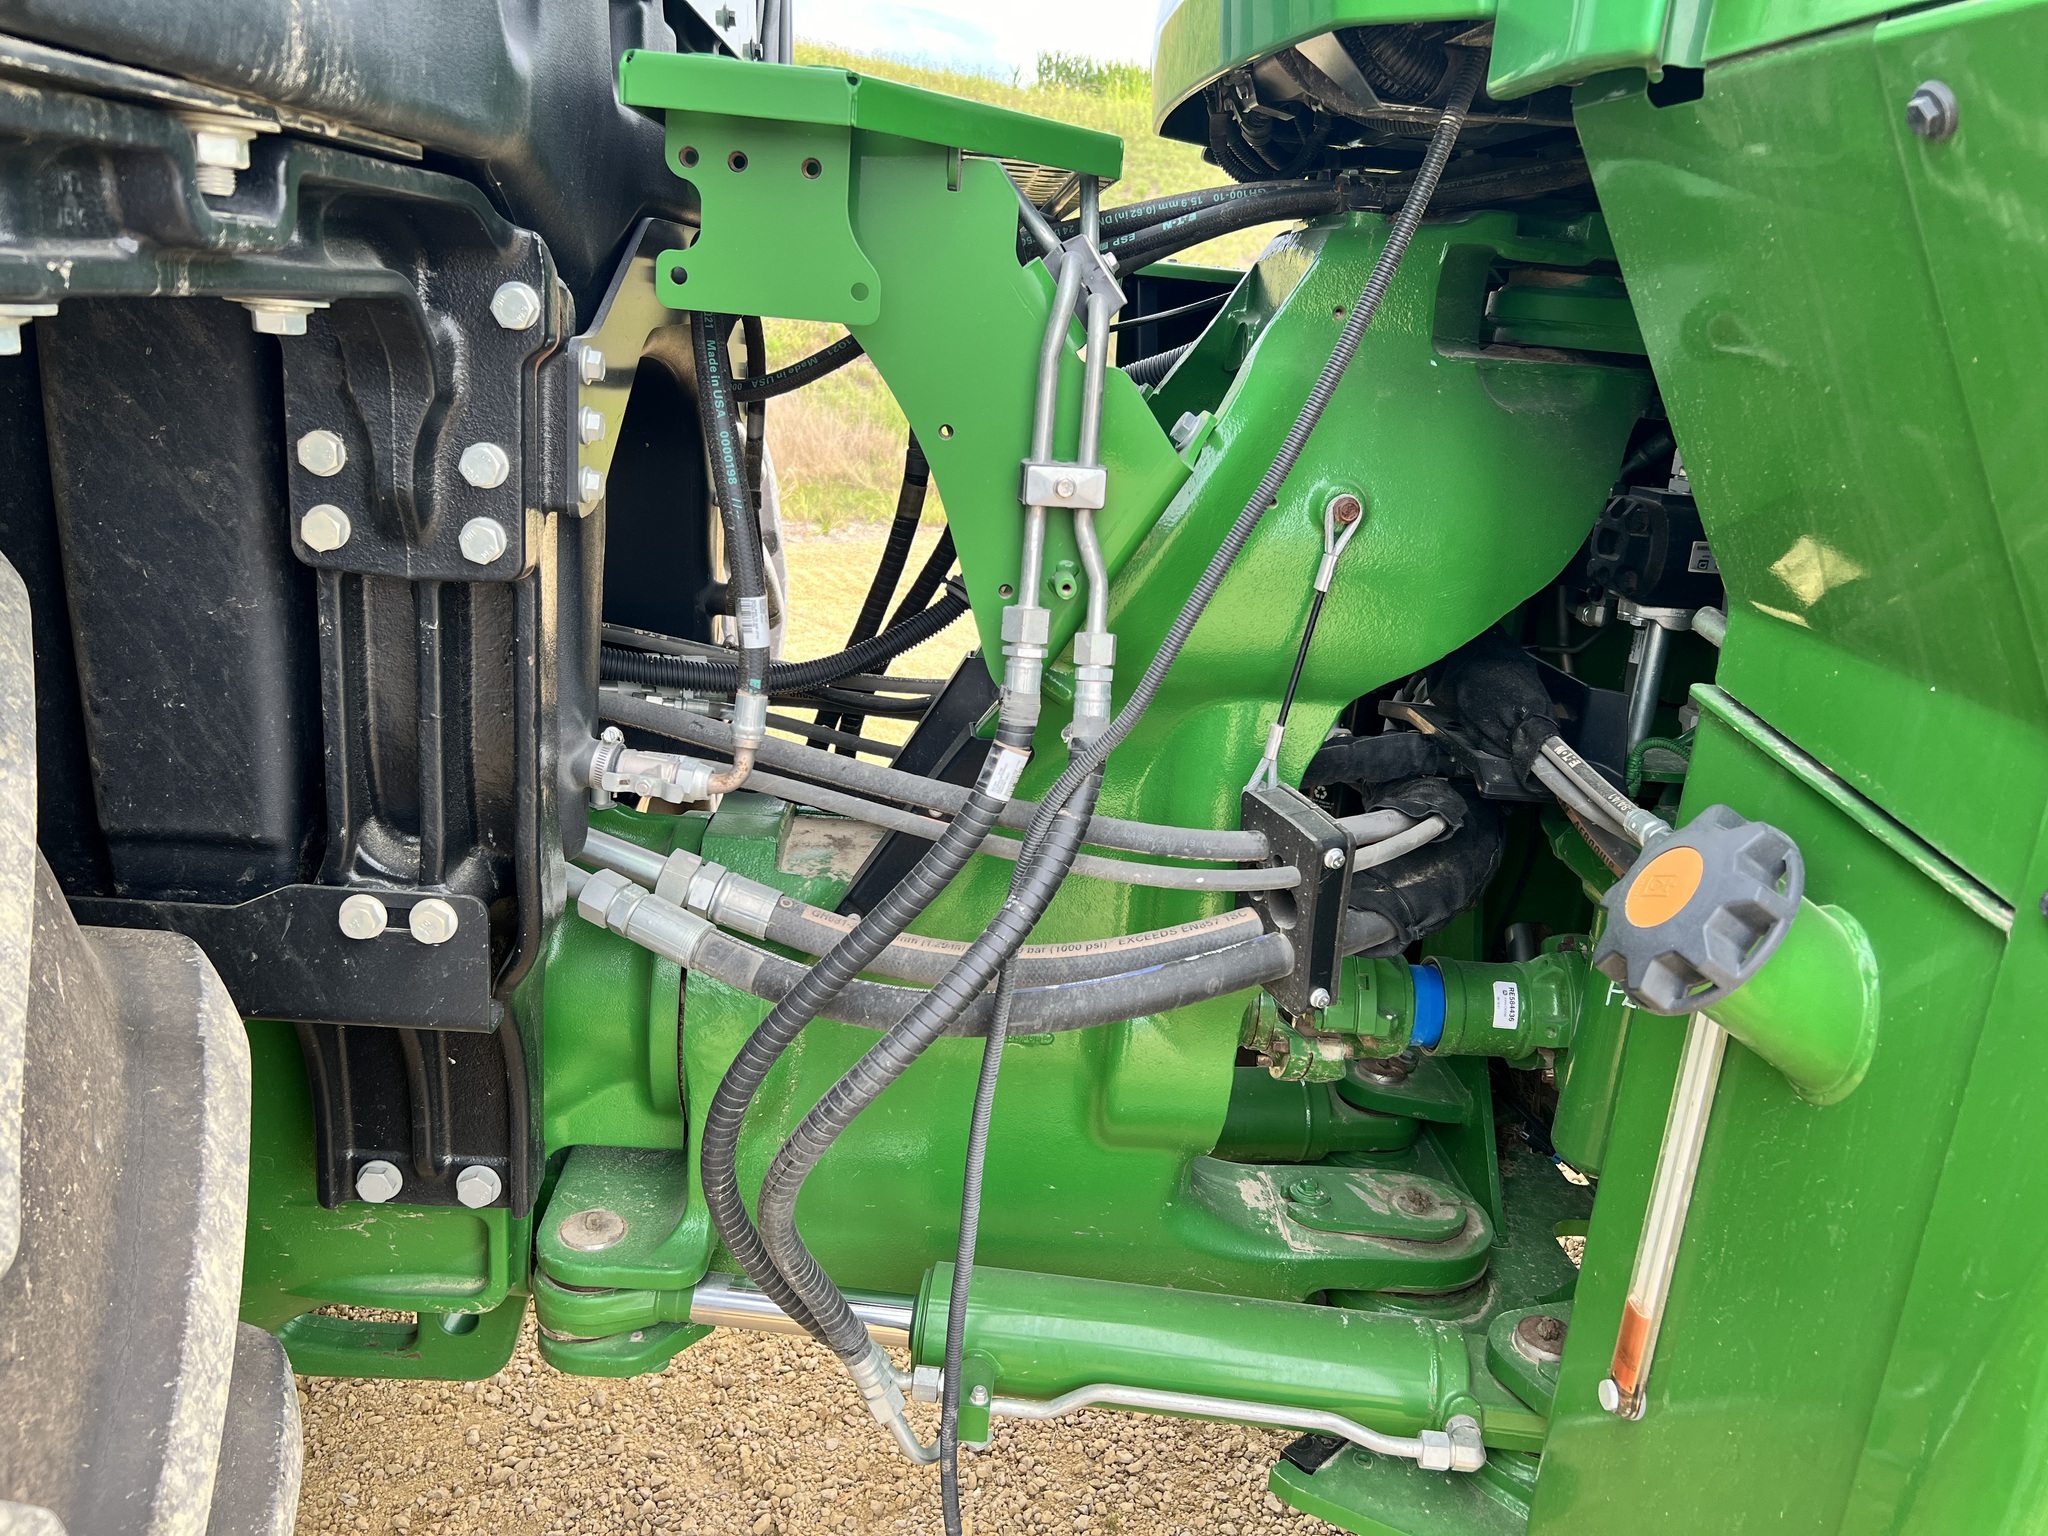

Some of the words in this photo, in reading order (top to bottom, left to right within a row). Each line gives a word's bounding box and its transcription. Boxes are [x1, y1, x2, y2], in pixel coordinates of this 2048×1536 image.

[1159, 200, 1180, 211] mm
[1182, 197, 1203, 208] 15.9
[1115, 209, 1130, 223] in)
[1129, 205, 1157, 218] (0.62
[1112, 233, 1136, 247] ESP
[705, 339, 718, 373] Made
[788, 356, 819, 375] Made
[711, 375, 721, 387] in
[751, 373, 775, 389] USA
[776, 370, 788, 380] in
[713, 389, 726, 418] USA
[720, 430, 738, 485] 0000198
[1026, 944, 1047, 955] bar
[1050, 943, 1083, 955] (1000
[1085, 940, 1108, 953] psi)
[1118, 927, 1178, 946] EXCEEDS
[1181, 918, 1220, 934] EN857
